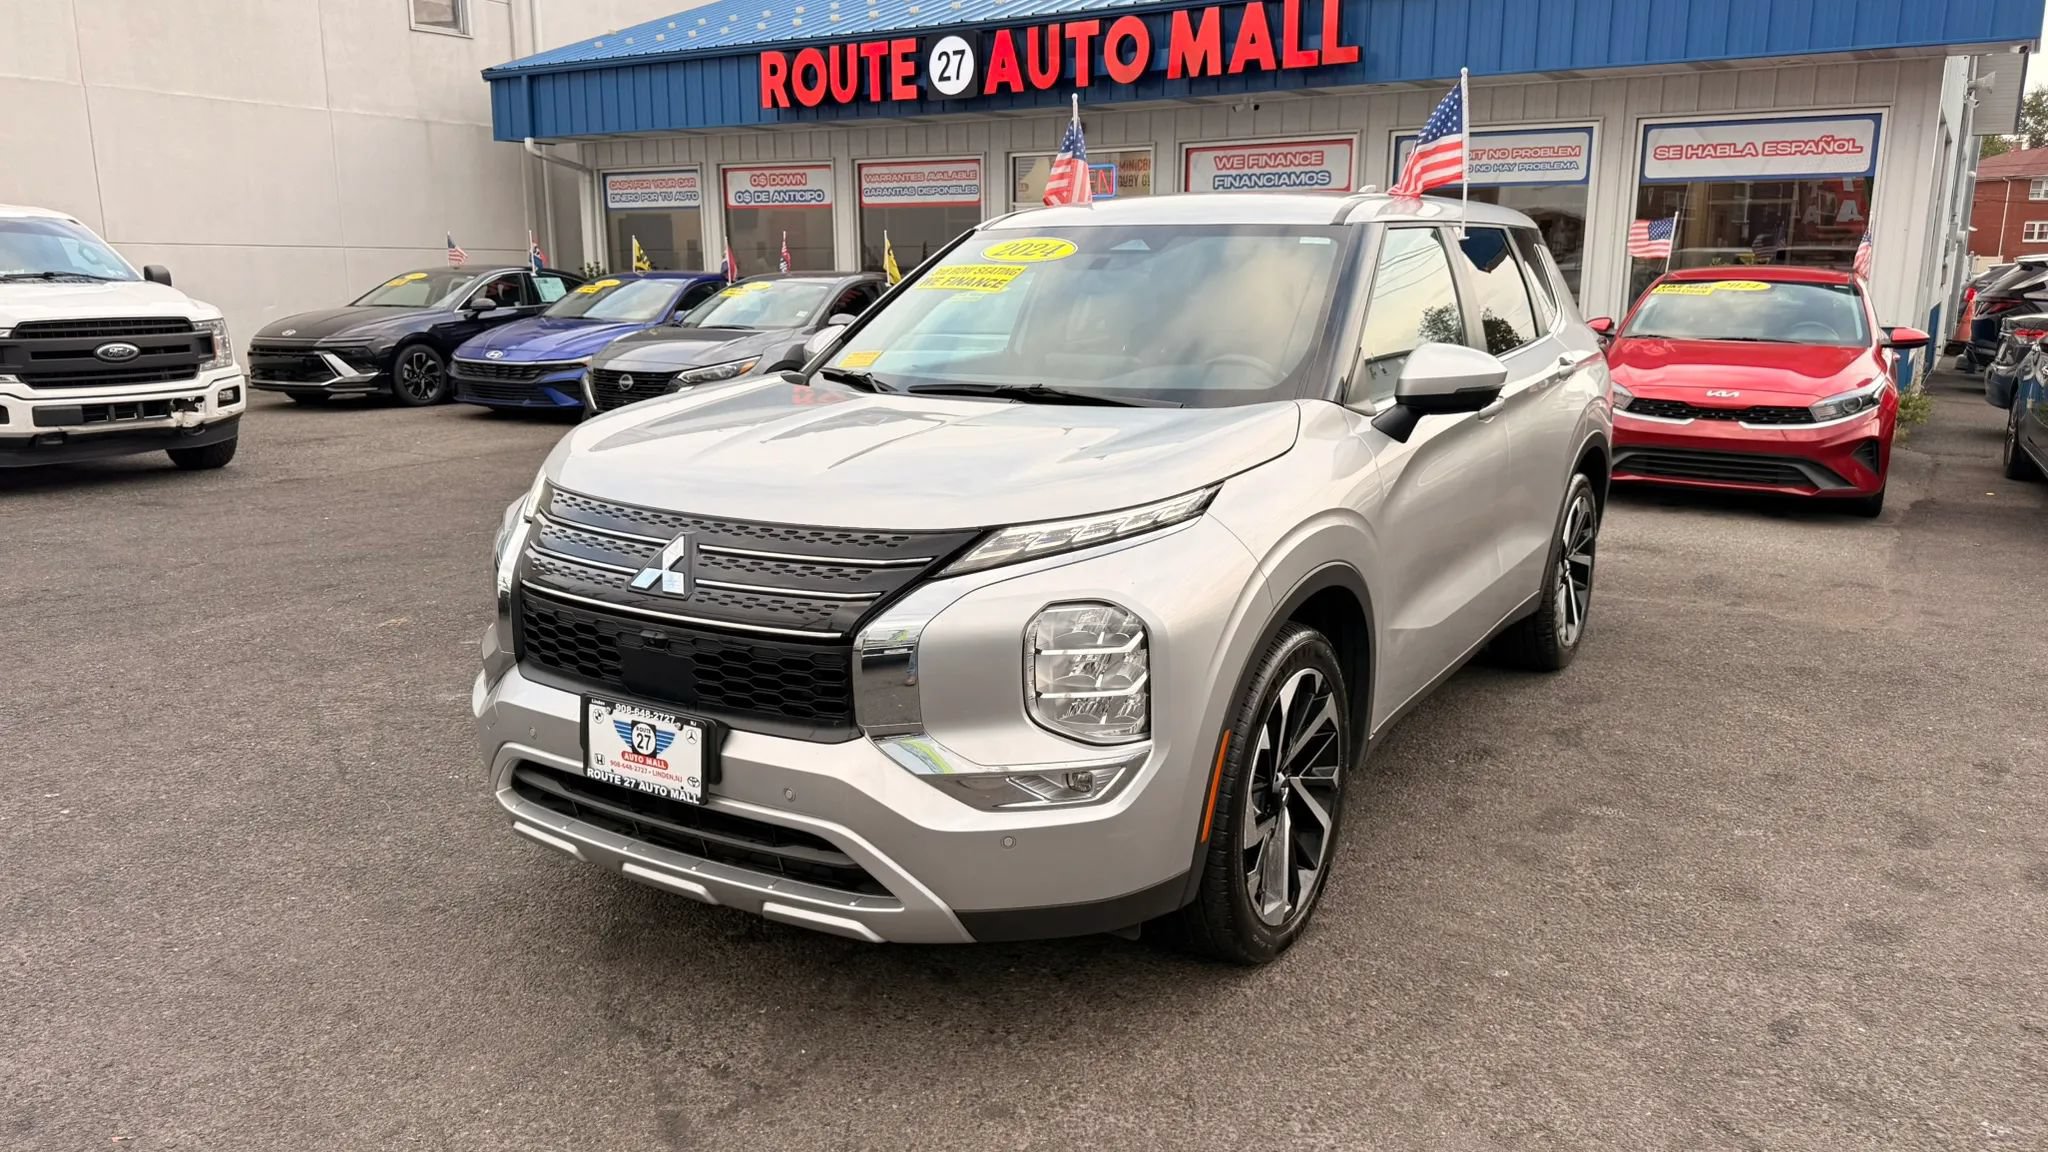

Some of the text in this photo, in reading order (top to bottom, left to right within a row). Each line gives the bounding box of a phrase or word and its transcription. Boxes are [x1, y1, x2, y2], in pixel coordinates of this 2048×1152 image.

[760, 0, 1359, 109] ROUTE 27 AUTO MALL
[1487, 149, 1510, 161] NO
[1511, 146, 1581, 160] PROBLEM
[1654, 134, 1863, 160] SE HABLA ESPAÑOL
[1214, 151, 1324, 170] WE FINANCE
[1475, 164, 1493, 173] NO
[1493, 163, 1517, 172] HAY
[1518, 161, 1580, 171] PROBLEMA
[609, 177, 696, 190] CASH FOR YOUR CAR
[769, 173, 807, 186] DOWN
[864, 170, 977, 184] WARRANTIES AVAILABLE
[1213, 171, 1332, 190] FINANCIAMOS
[610, 191, 699, 203] DINERO POR TU AUTO
[753, 190, 770, 203] DE
[772, 189, 825, 203] ANTICIPO
[863, 184, 979, 197] GARANTIAS DISPONIBLES
[993, 242, 1067, 257] 2024
[942, 276, 1008, 288] FINANCE
[615, 703, 675, 724] 908-648-2727
[636, 726, 651, 734] ROUTE
[636, 732, 651, 750] 27
[624, 752, 667, 769] AUTO MALL
[587, 768, 700, 804] ROUTE 27 AUTO MALL
